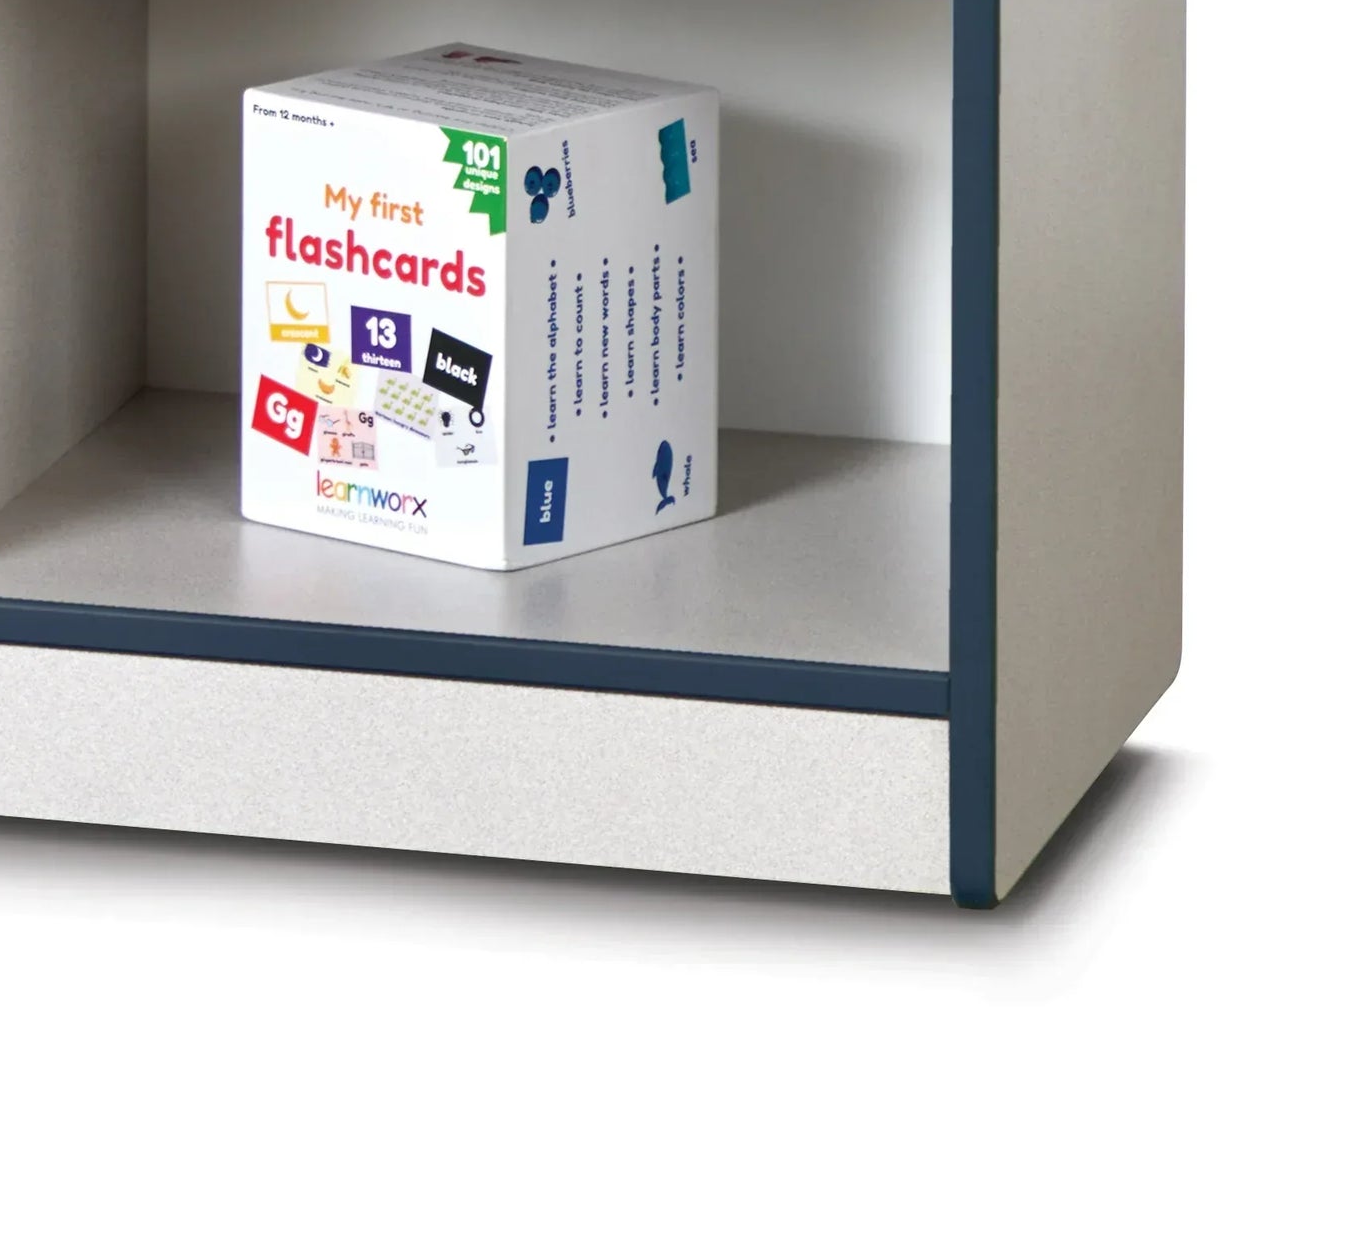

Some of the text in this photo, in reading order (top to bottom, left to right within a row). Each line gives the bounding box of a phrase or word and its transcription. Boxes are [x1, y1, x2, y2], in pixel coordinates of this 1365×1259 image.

[253, 104, 277, 118] From
[279, 109, 290, 120] 12
[292, 111, 328, 127] months
[462, 140, 501, 170] 101
[465, 165, 499, 180] unique
[690, 140, 698, 163] sea
[463, 178, 501, 195] designs
[561, 140, 576, 218] blueberries
[324, 183, 425, 226] My first
[265, 215, 487, 297] flashcards
[365, 316, 398, 349] 13
[600, 270, 610, 407] learn new words
[625, 279, 637, 386] learn shapes
[650, 256, 662, 395] learn body parts
[676, 269, 686, 370] learn colors
[362, 352, 402, 369] thirteen
[547, 273, 559, 430] learn the alphabet
[574, 285, 584, 405] learn to count
[435, 352, 479, 387] black
[266, 392, 305, 440] Gg
[358, 411, 374, 428] Gg
[316, 469, 428, 518] learnworx
[683, 454, 693, 497] whale
[316, 505, 428, 536] MAKING LEARNING FUN
[539, 480, 554, 523] blue
